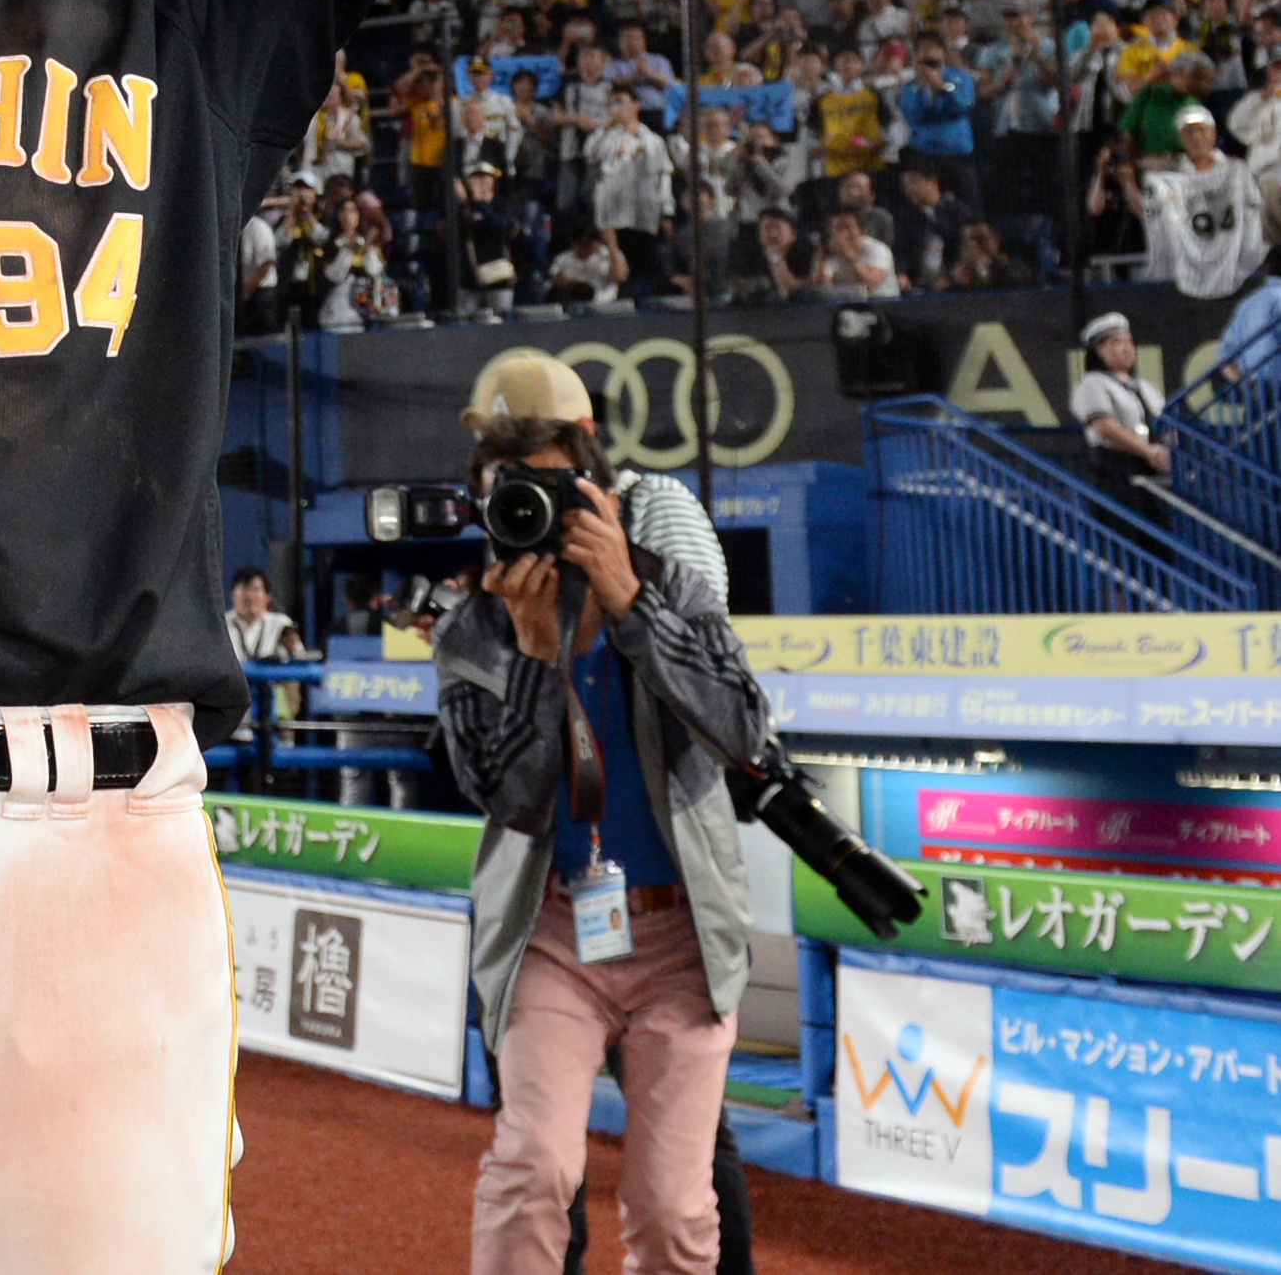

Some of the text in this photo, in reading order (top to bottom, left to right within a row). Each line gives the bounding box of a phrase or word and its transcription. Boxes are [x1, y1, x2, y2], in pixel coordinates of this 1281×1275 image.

[854, 625, 1001, 668] 千葉東建設
[241, 808, 381, 863] レオガーデン
[998, 885, 1274, 963] レオガーデン
[864, 1119, 962, 1162] THREE V
